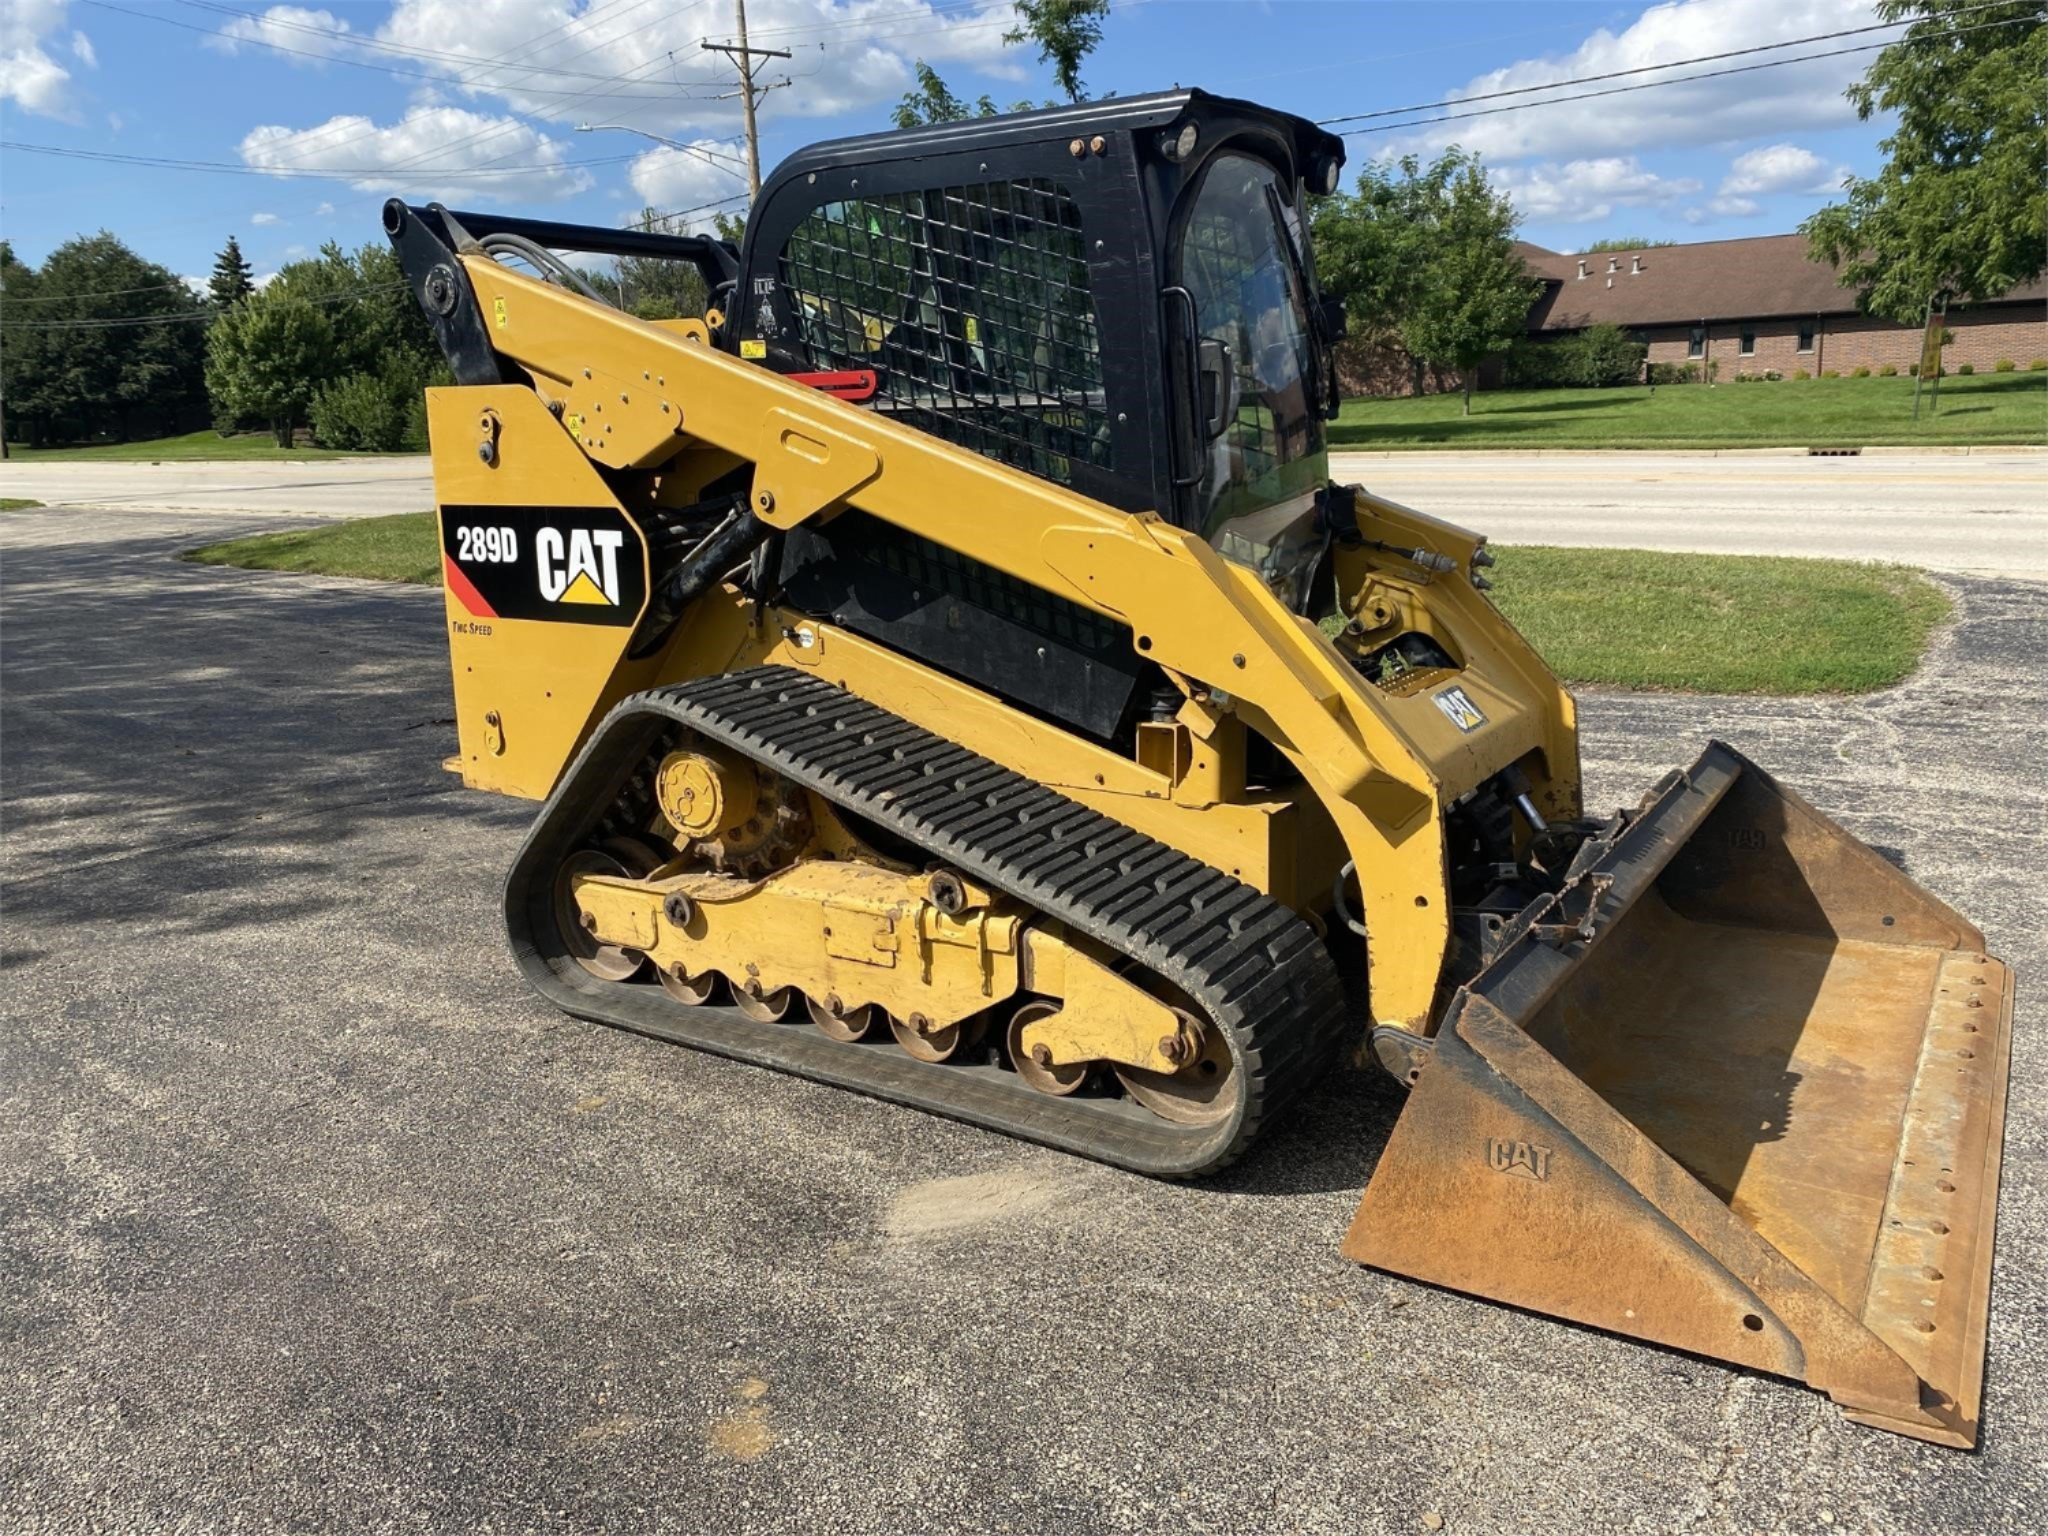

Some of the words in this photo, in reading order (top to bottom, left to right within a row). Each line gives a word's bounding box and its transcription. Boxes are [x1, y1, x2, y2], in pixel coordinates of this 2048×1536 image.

[457, 526, 518, 563] 289D
[536, 527, 623, 606] CAT
[1439, 690, 1484, 730] CAT
[1488, 1137, 1551, 1182] CAT
